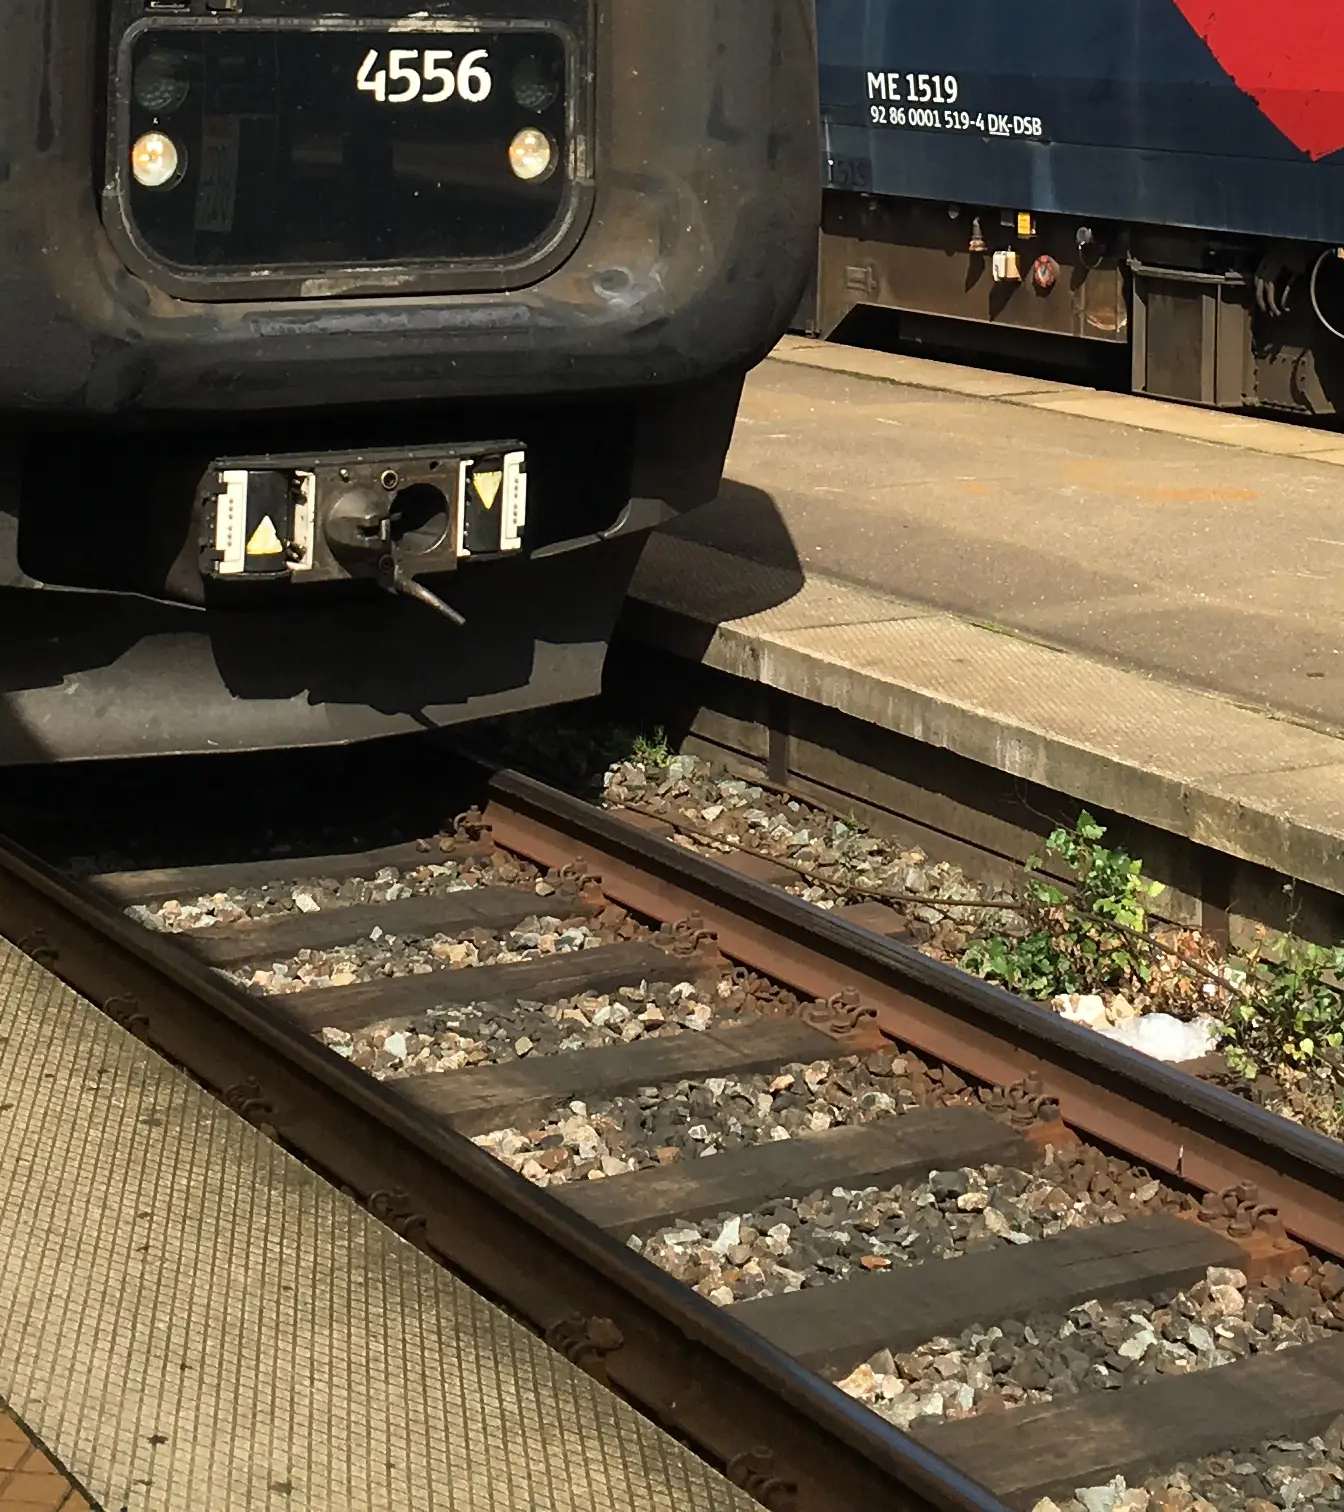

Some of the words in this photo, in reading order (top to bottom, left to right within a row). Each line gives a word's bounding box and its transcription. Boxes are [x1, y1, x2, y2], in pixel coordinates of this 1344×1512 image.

[356, 48, 492, 103] 4556
[867, 71, 901, 101] ME
[906, 73, 958, 104] 1519
[870, 105, 887, 124] 92
[889, 107, 906, 125] 86
[908, 108, 942, 128] 0001
[944, 110, 984, 131] 519-4
[987, 113, 1042, 136] DK-DSB
